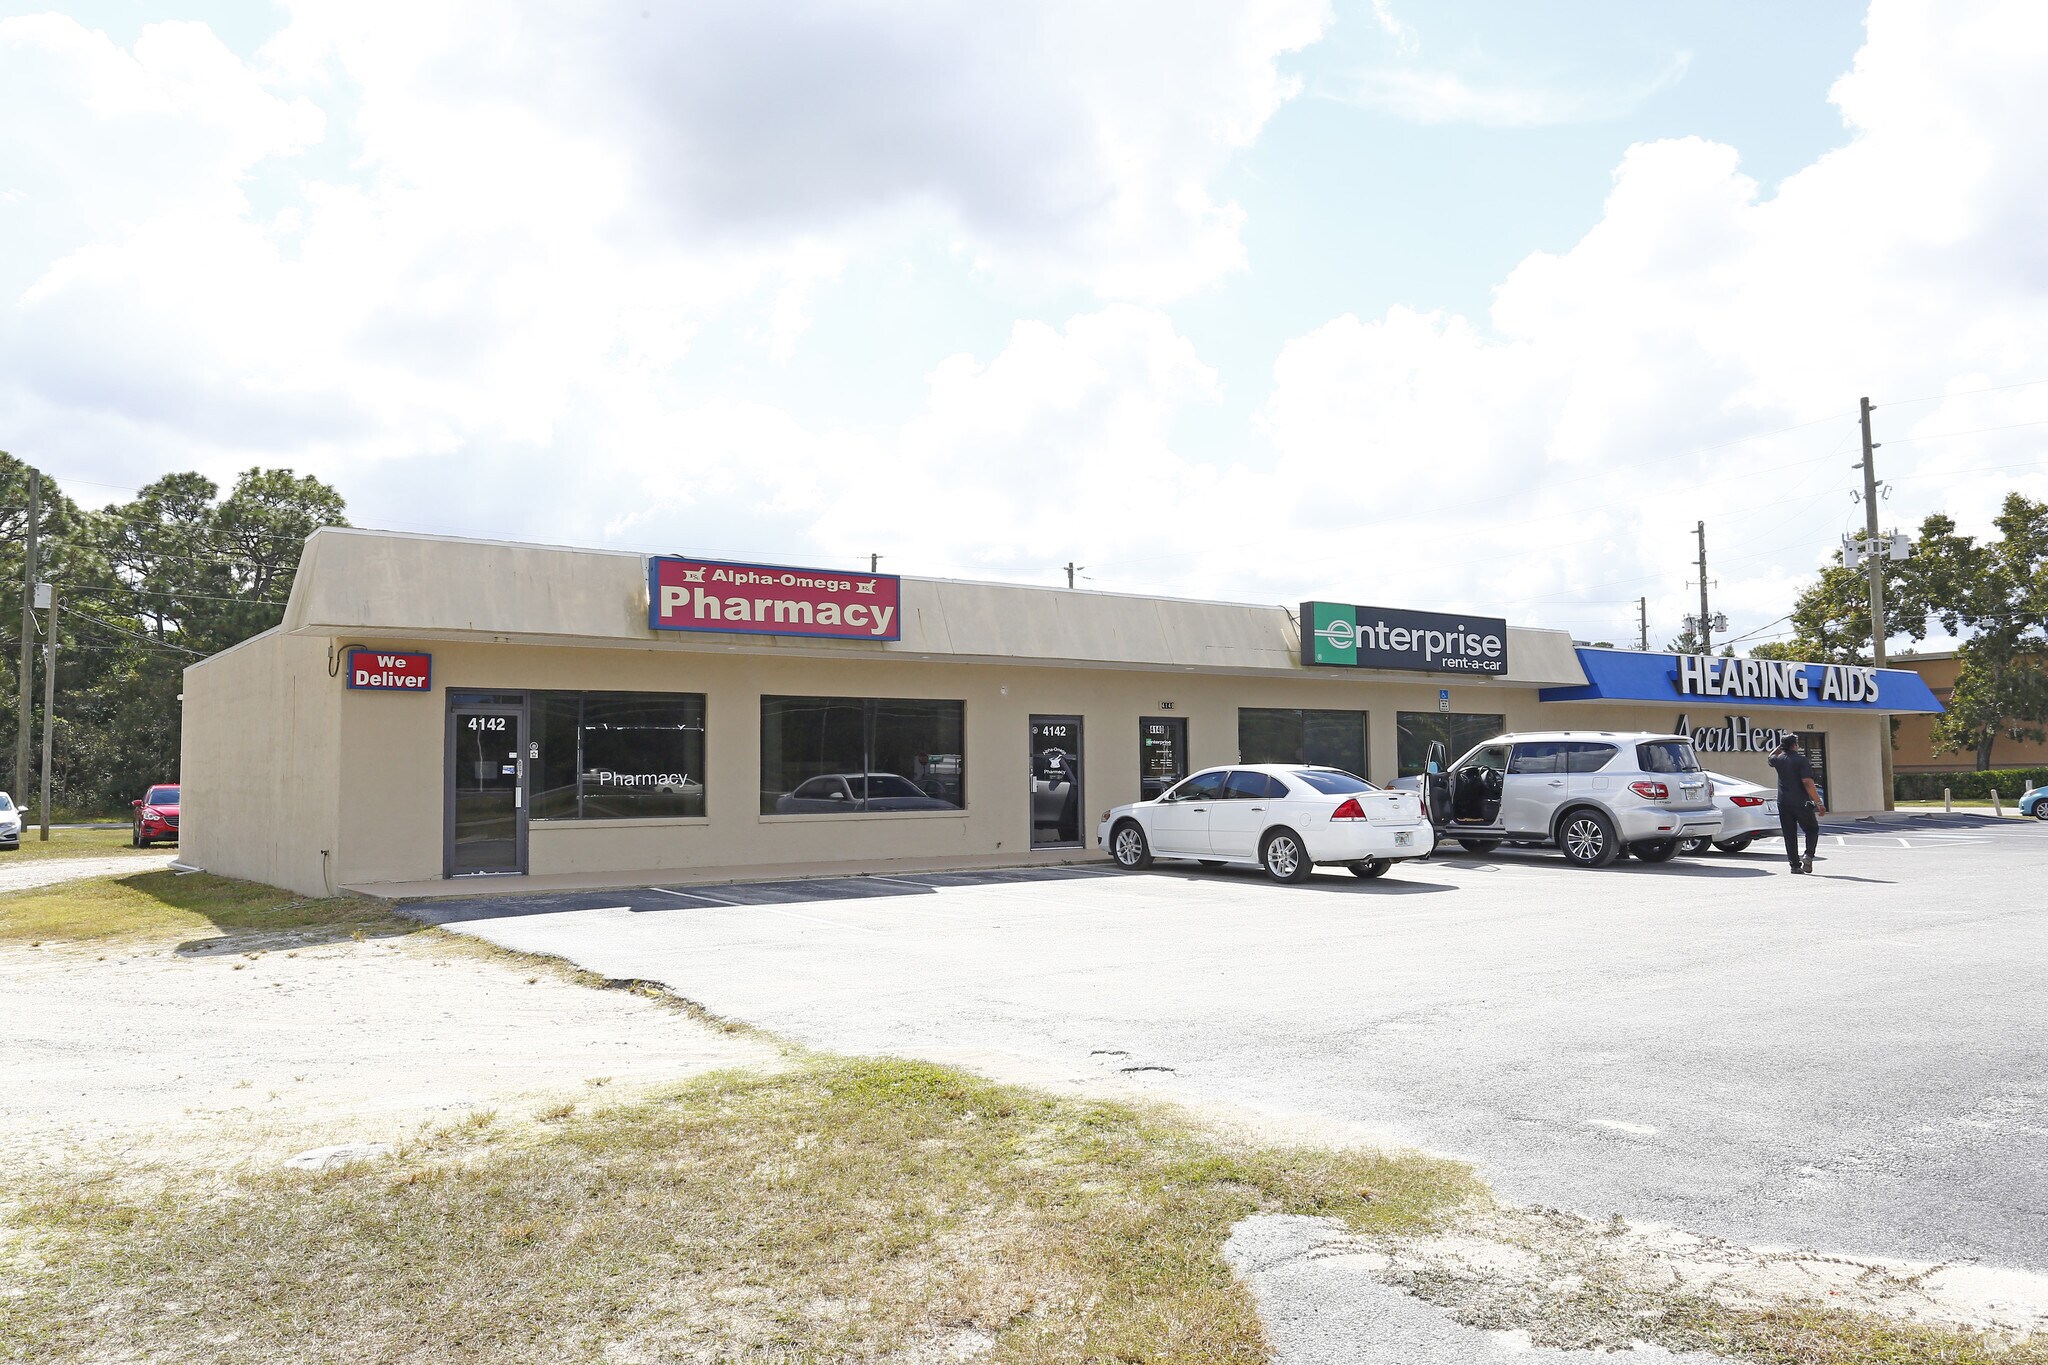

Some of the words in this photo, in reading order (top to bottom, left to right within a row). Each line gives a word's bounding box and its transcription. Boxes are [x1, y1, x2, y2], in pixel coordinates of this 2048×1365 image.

[711, 569, 851, 592] Alpha-Omega
[660, 585, 895, 635] Pharmacy
[1315, 619, 1501, 661] enterprise
[377, 655, 407, 668] We
[1442, 656, 1501, 671] rent-a-car
[355, 670, 426, 687] Deliver
[1679, 655, 1809, 700] HEARING
[1822, 665, 1879, 703] AIDS
[468, 717, 506, 731] 4142
[1042, 725, 1066, 737] 4142
[600, 771, 688, 788] Pharmacy
